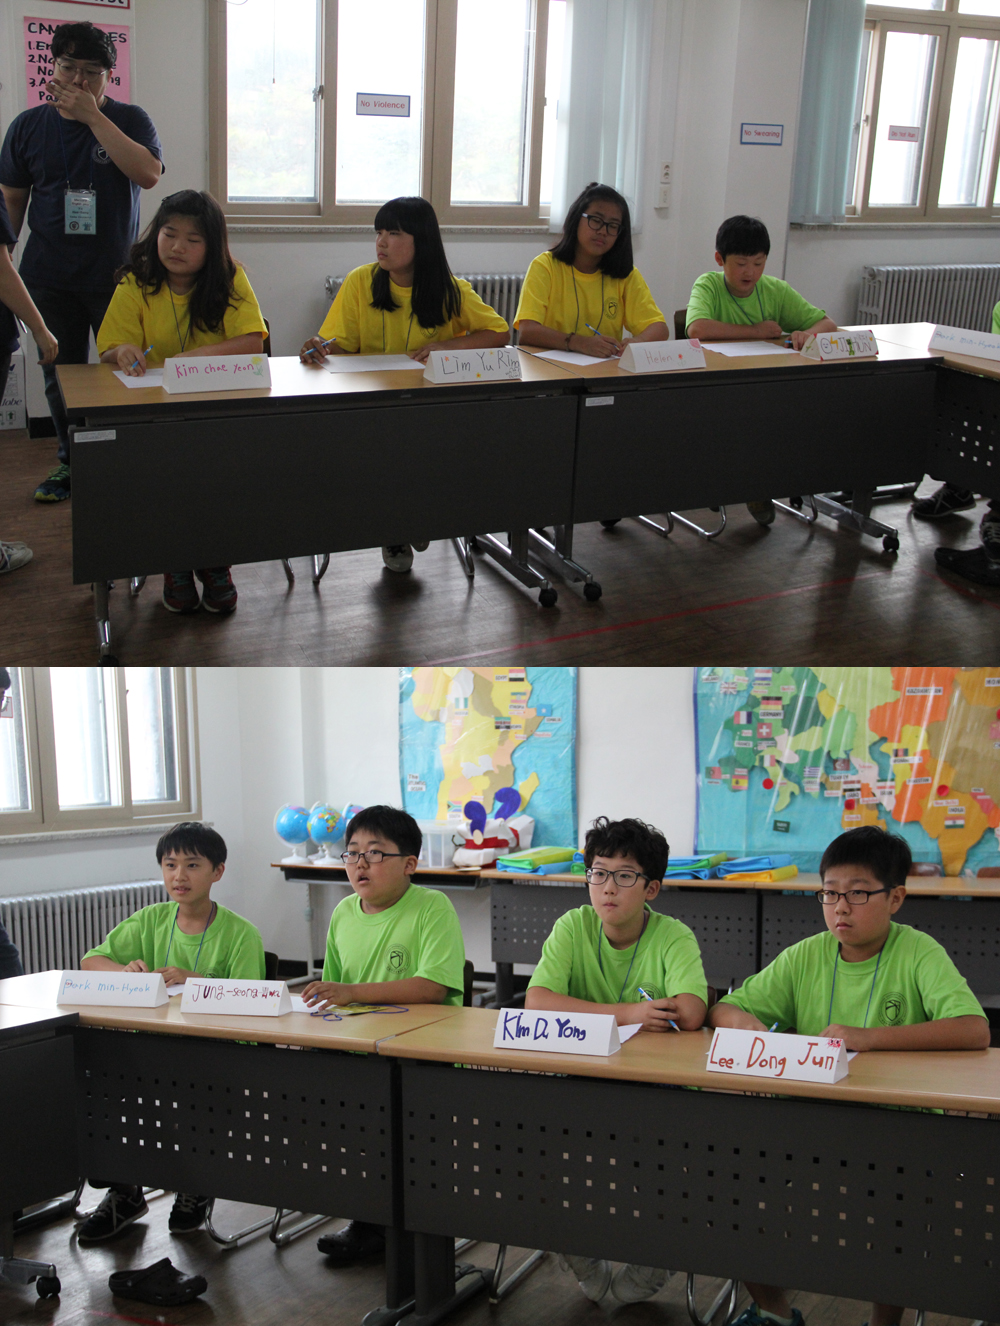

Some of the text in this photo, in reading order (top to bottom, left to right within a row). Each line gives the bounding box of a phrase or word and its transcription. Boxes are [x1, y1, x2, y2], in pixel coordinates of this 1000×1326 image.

[373, 101, 406, 109] Violence
[753, 130, 780, 138] Swearing
[644, 349, 672, 364] Helen
[62, 979, 91, 995] Park
[746, 1037, 787, 1077] Dong
[798, 1042, 835, 1070] Jun
